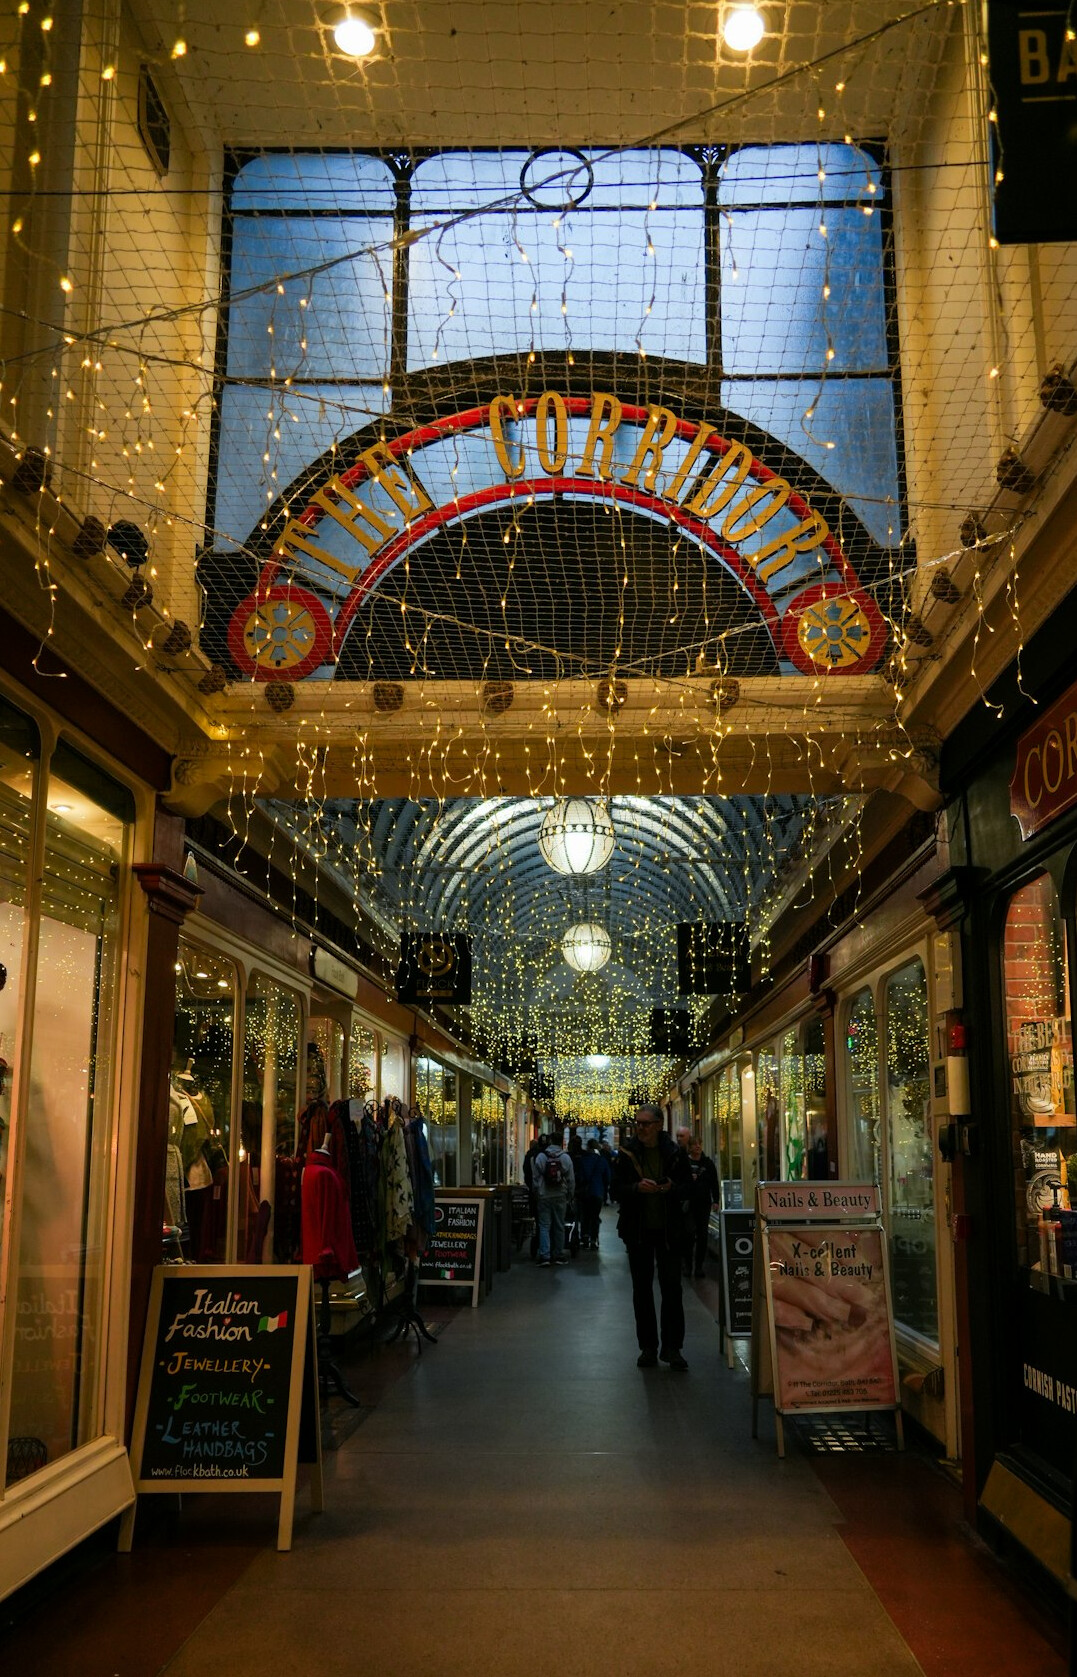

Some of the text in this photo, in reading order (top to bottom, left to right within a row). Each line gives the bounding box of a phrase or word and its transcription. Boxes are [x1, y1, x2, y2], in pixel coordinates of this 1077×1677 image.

[273, 390, 830, 585] THE CORRIDOR
[1036, 1017, 1067, 1049] BEST
[768, 1191, 871, 1209] Nails & Beauty
[448, 1206, 477, 1215] ITALIAN
[447, 1218, 476, 1227] FASHION
[430, 1240, 468, 1249] JEWELLERY
[792, 1242, 857, 1259] X-cellent
[434, 1250, 469, 1258] FOOTWEAR
[780, 1261, 872, 1280] Nails & Beauty
[188, 1289, 261, 1315] Italian
[165, 1313, 253, 1342] Fashion
[1023, 1363, 1077, 1415] CORNISH PAST
[151, 1463, 249, 1478] www.flockbath.co.uk
